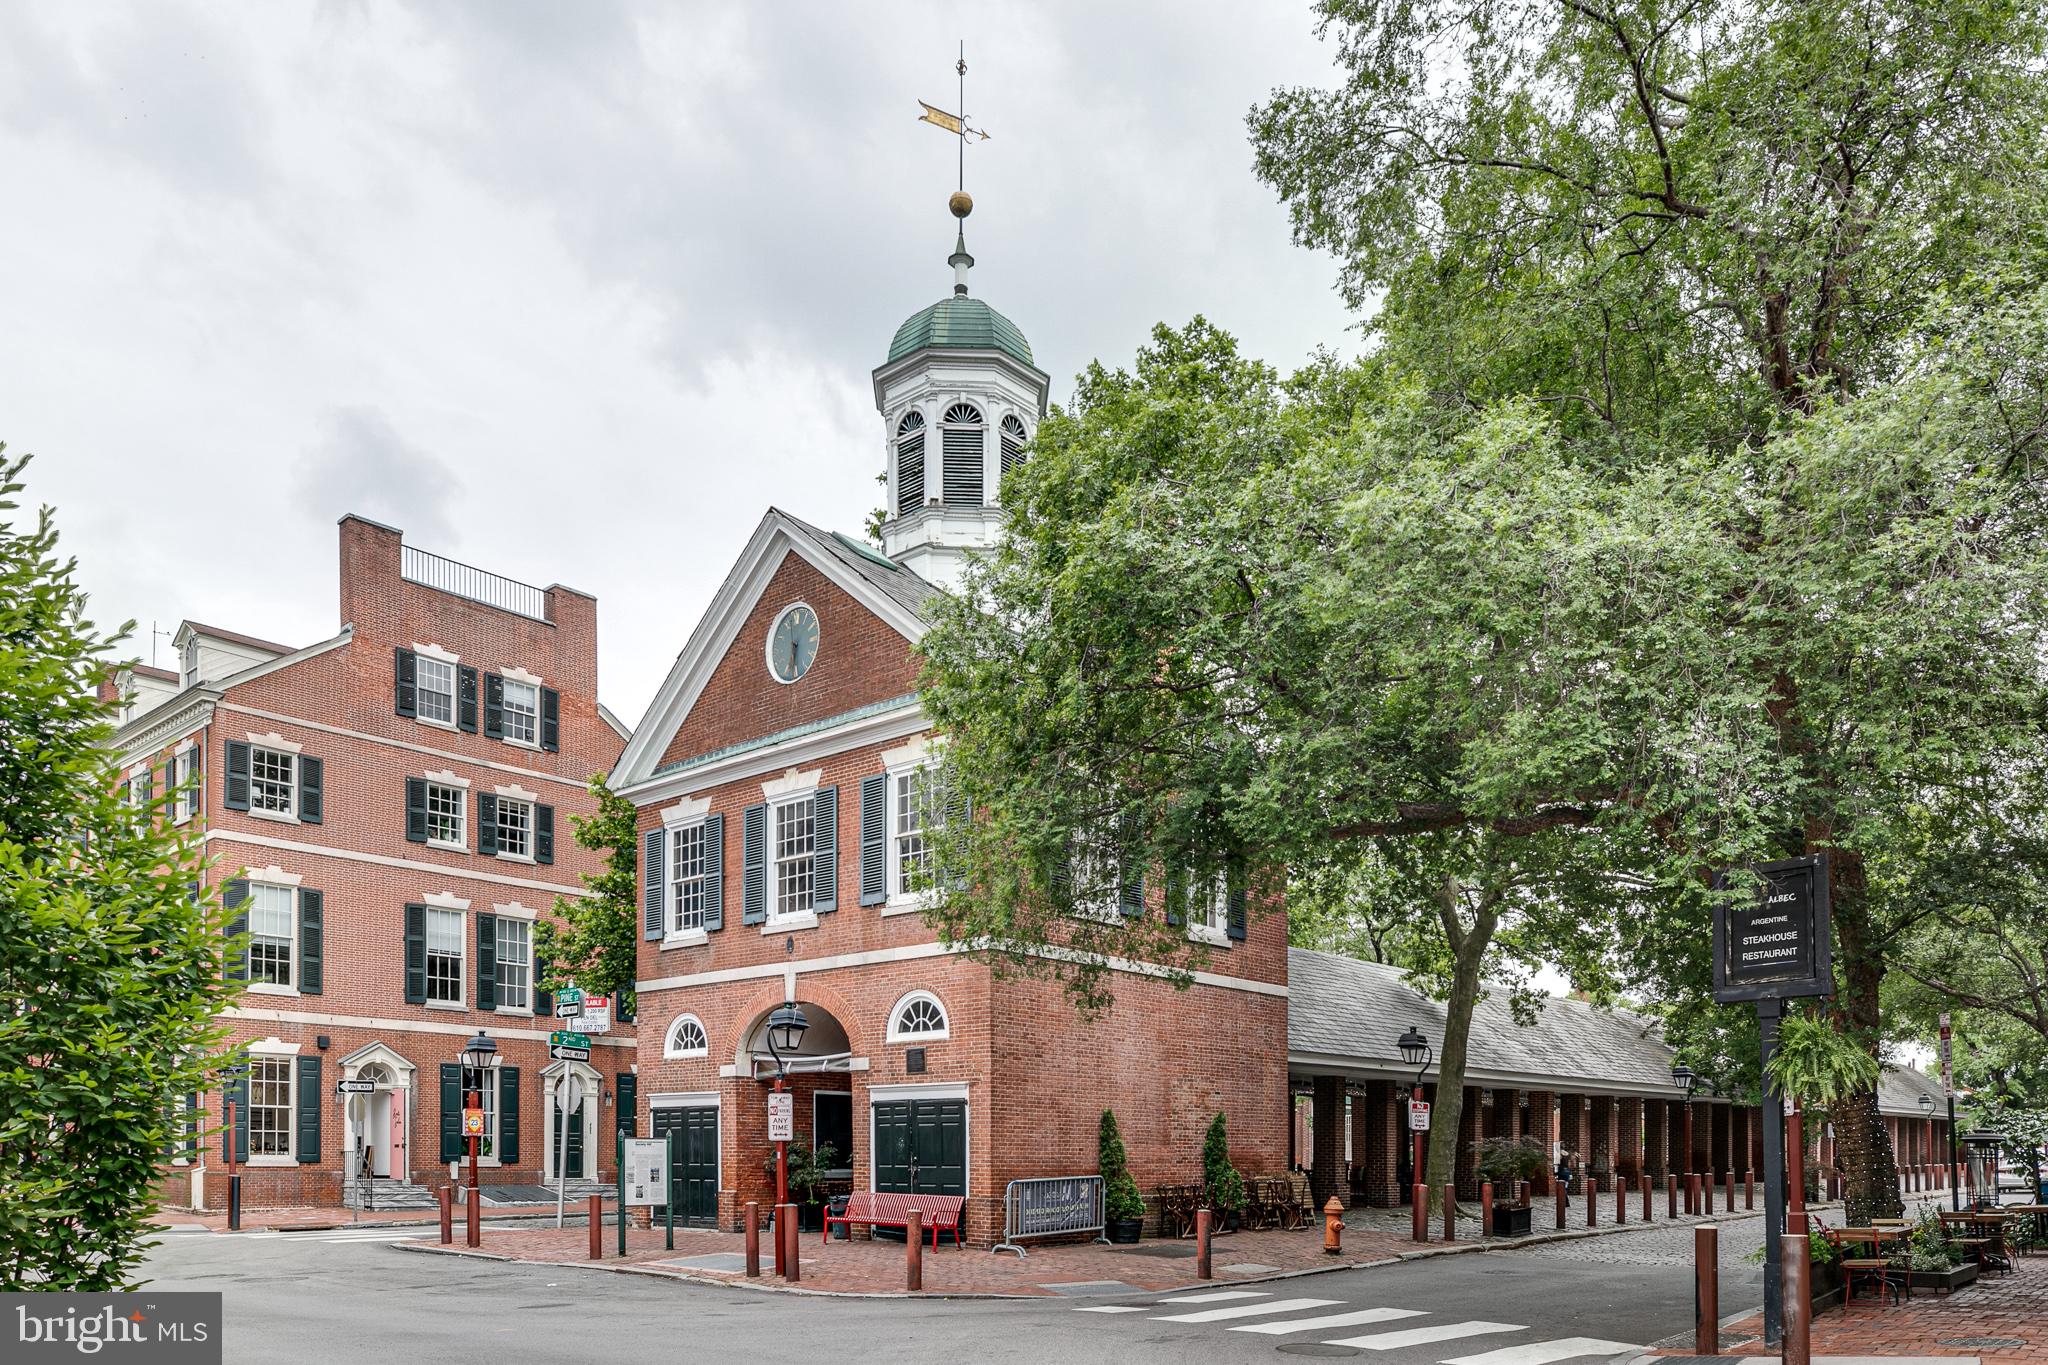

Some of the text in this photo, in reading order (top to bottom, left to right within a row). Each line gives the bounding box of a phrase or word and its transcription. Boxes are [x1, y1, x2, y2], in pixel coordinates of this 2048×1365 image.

[1767, 893, 1797, 904] ALBEC
[1750, 915, 1788, 926] ARGENTINE
[1742, 931, 1798, 945] STEAKHOUSE
[1742, 947, 1798, 961] RESTAURANT
[560, 993, 573, 1003] PINE
